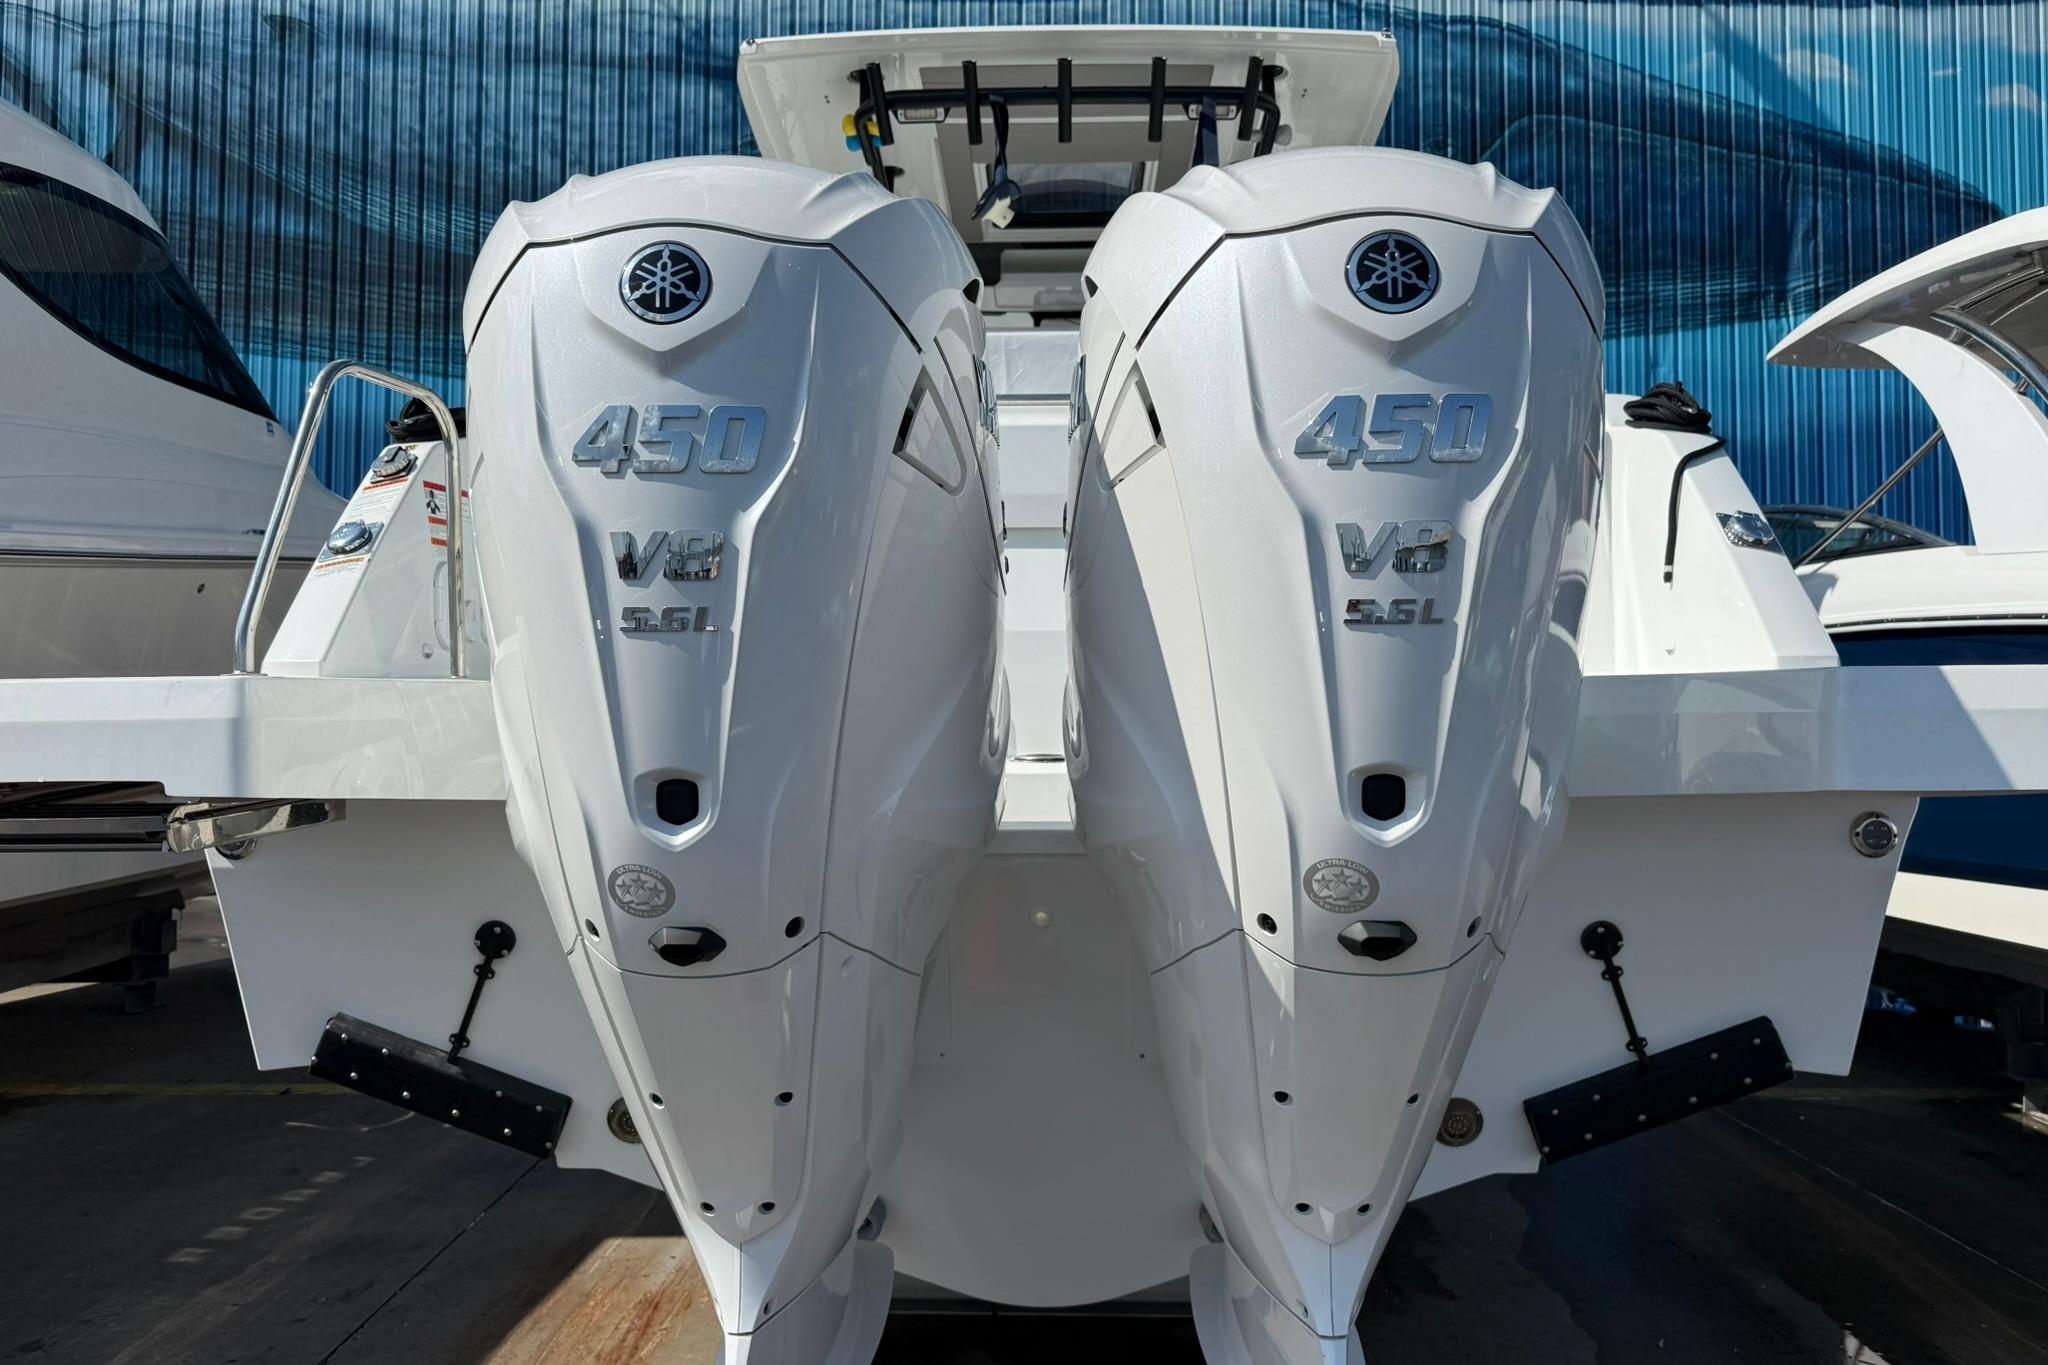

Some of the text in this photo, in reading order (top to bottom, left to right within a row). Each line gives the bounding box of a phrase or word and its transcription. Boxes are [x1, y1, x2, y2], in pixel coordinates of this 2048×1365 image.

[572, 404, 768, 475] 450
[1294, 392, 1492, 465] 450
[609, 529, 725, 581] V8
[1335, 520, 1455, 573] V8
[619, 606, 719, 632] 5.6L
[1343, 598, 1444, 625] 5.6L
